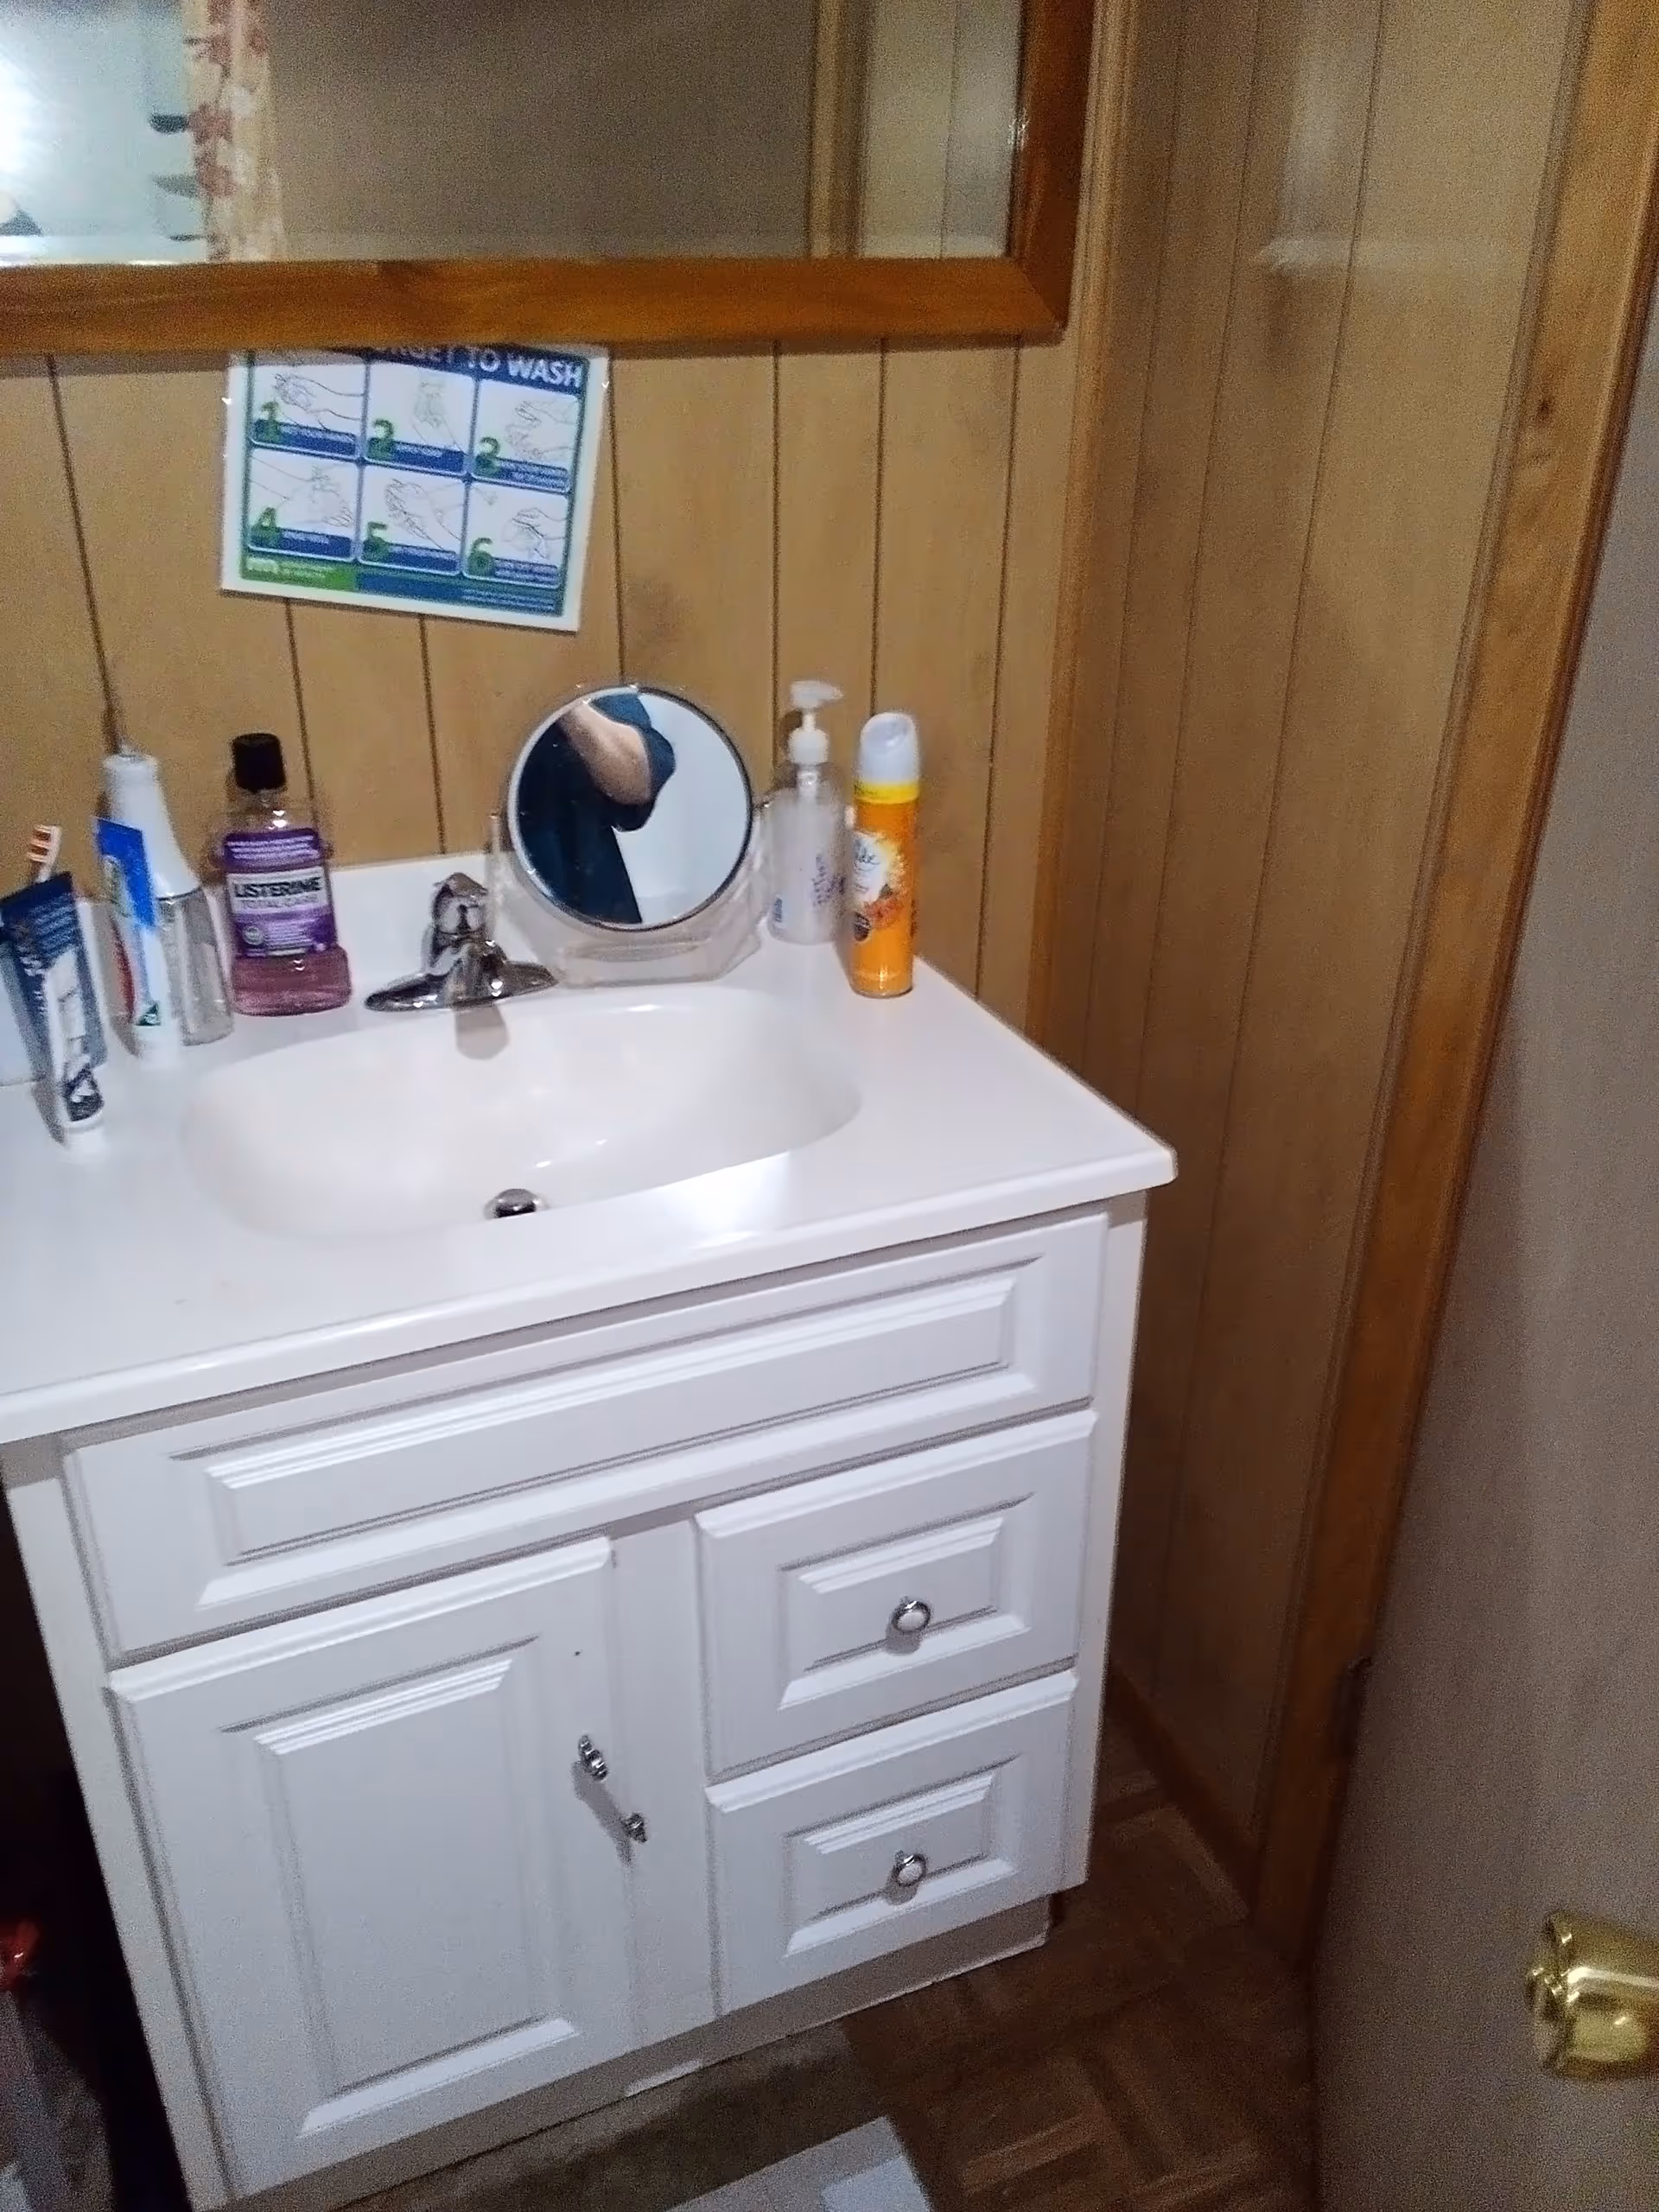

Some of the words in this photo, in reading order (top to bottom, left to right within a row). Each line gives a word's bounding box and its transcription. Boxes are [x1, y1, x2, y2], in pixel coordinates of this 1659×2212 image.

[467, 348, 501, 372] TO
[506, 353, 582, 388] WASH
[467, 537, 496, 576] 6
[233, 877, 321, 898] LISTERINE
